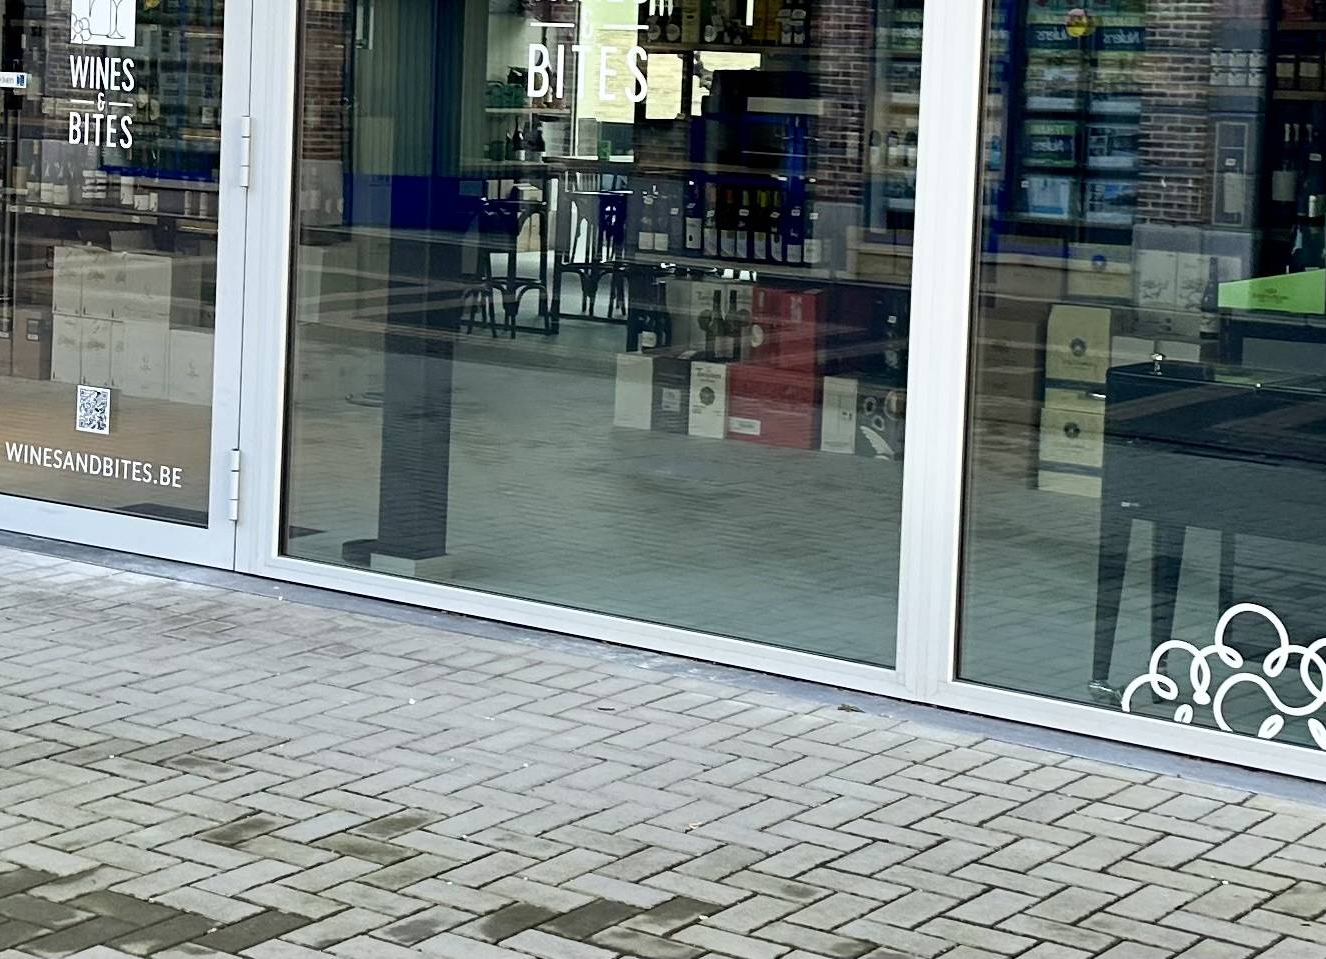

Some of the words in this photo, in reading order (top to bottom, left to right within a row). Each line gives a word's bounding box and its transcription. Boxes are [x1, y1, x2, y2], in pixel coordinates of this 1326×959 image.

[69, 54, 135, 92] WINES
[527, 43, 648, 103] BITES
[97, 92, 106, 112] &
[68, 111, 133, 149] BITES
[5, 441, 183, 488] WINESANDBITES.BE
